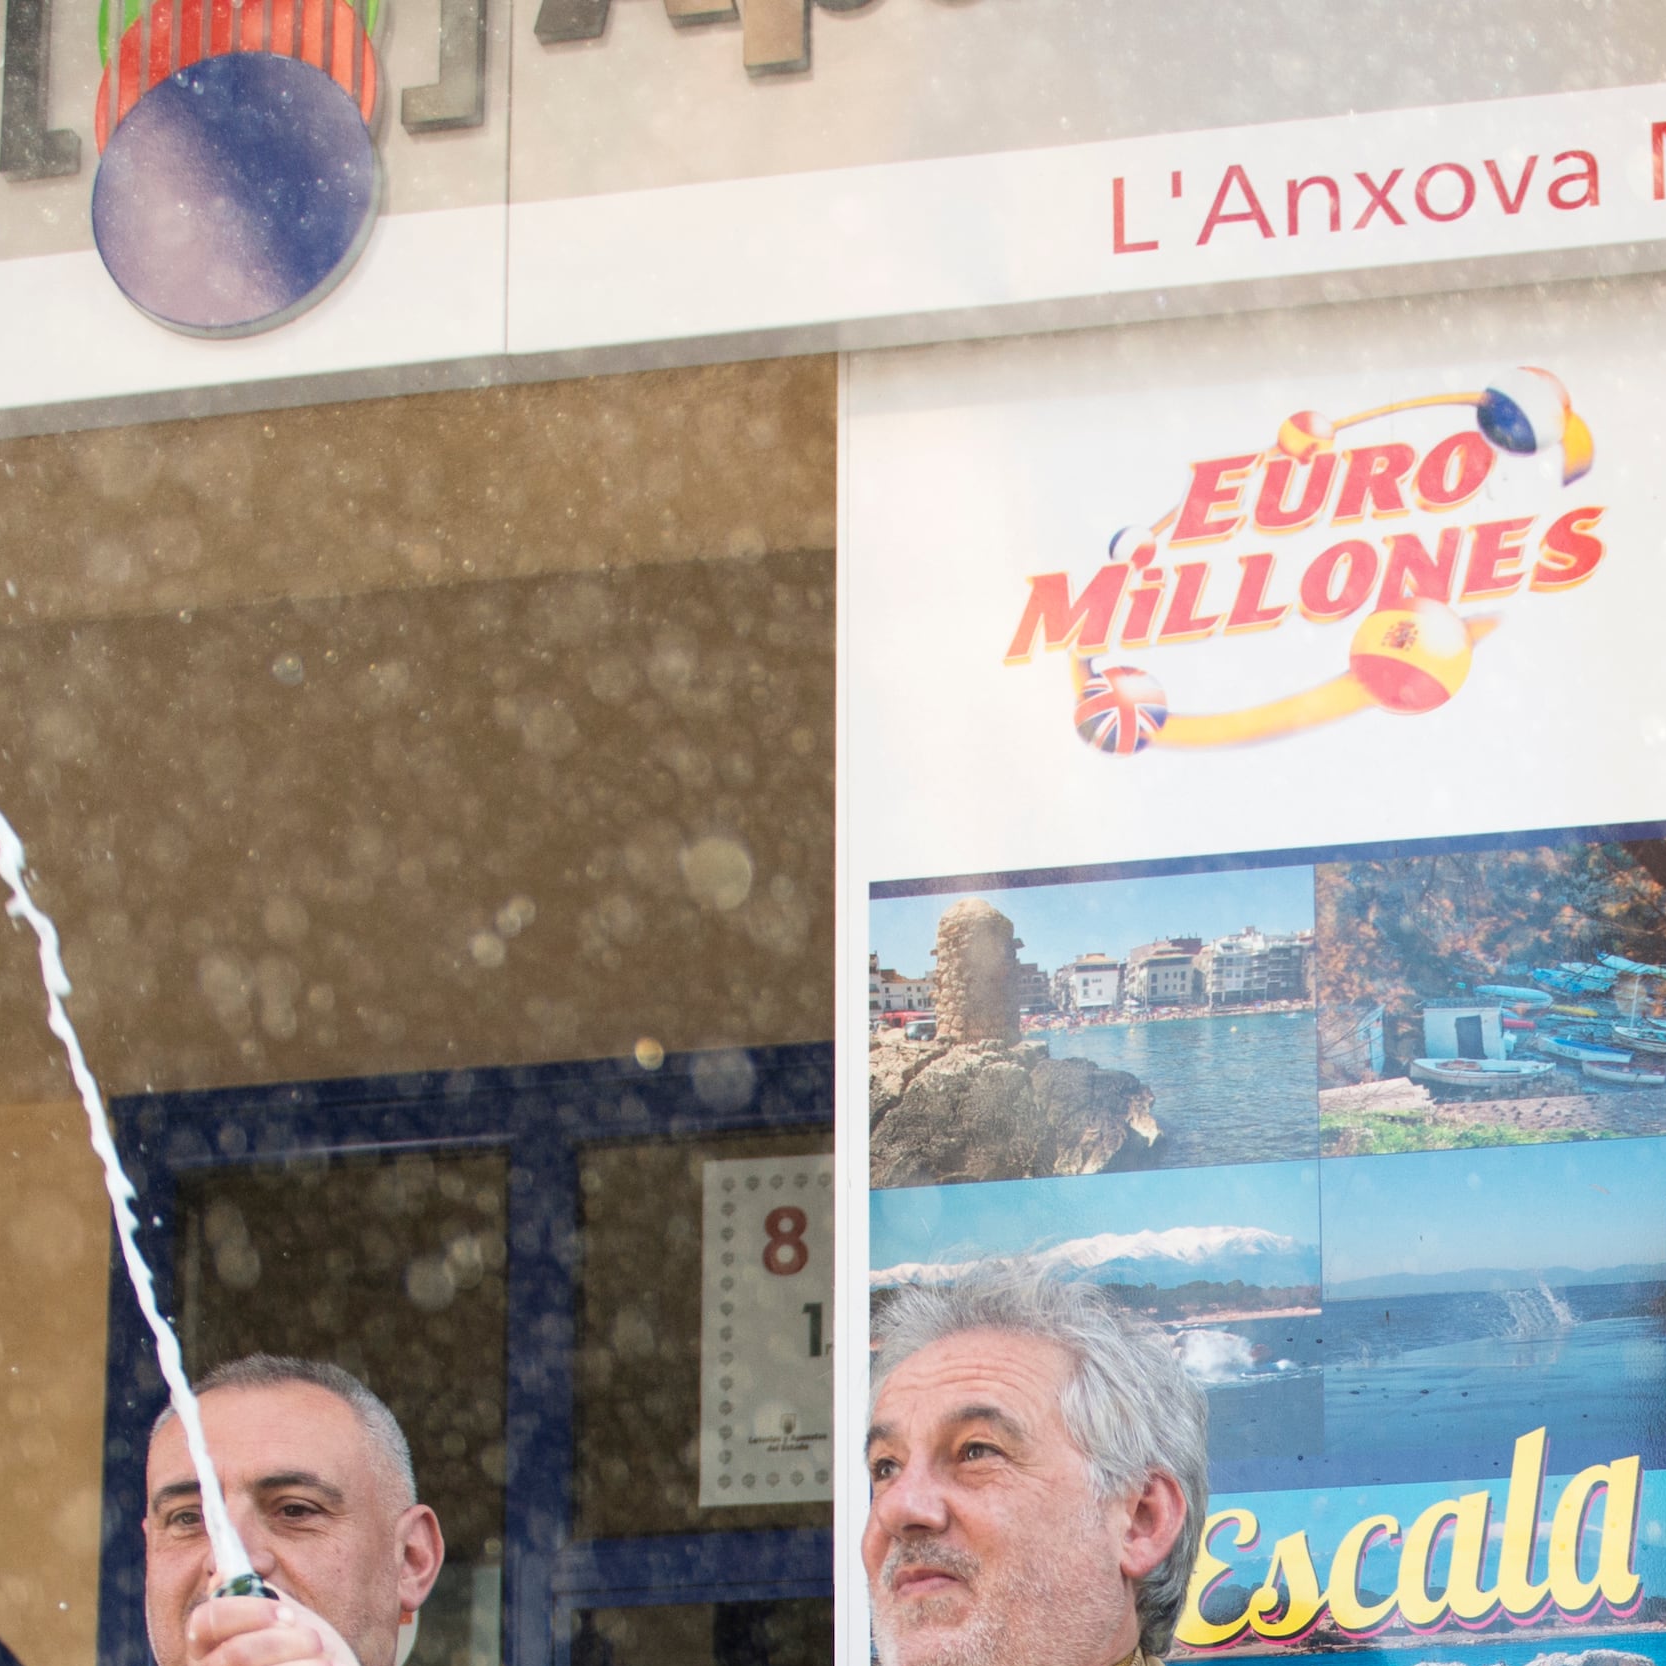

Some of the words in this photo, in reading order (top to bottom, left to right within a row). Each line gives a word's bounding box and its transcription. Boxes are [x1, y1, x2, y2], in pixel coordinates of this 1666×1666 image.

[1111, 148, 1601, 254] L'Anxova
[1169, 430, 1498, 549] EURO
[763, 1206, 808, 1276] 8
[1173, 1425, 1645, 1650] Escala
